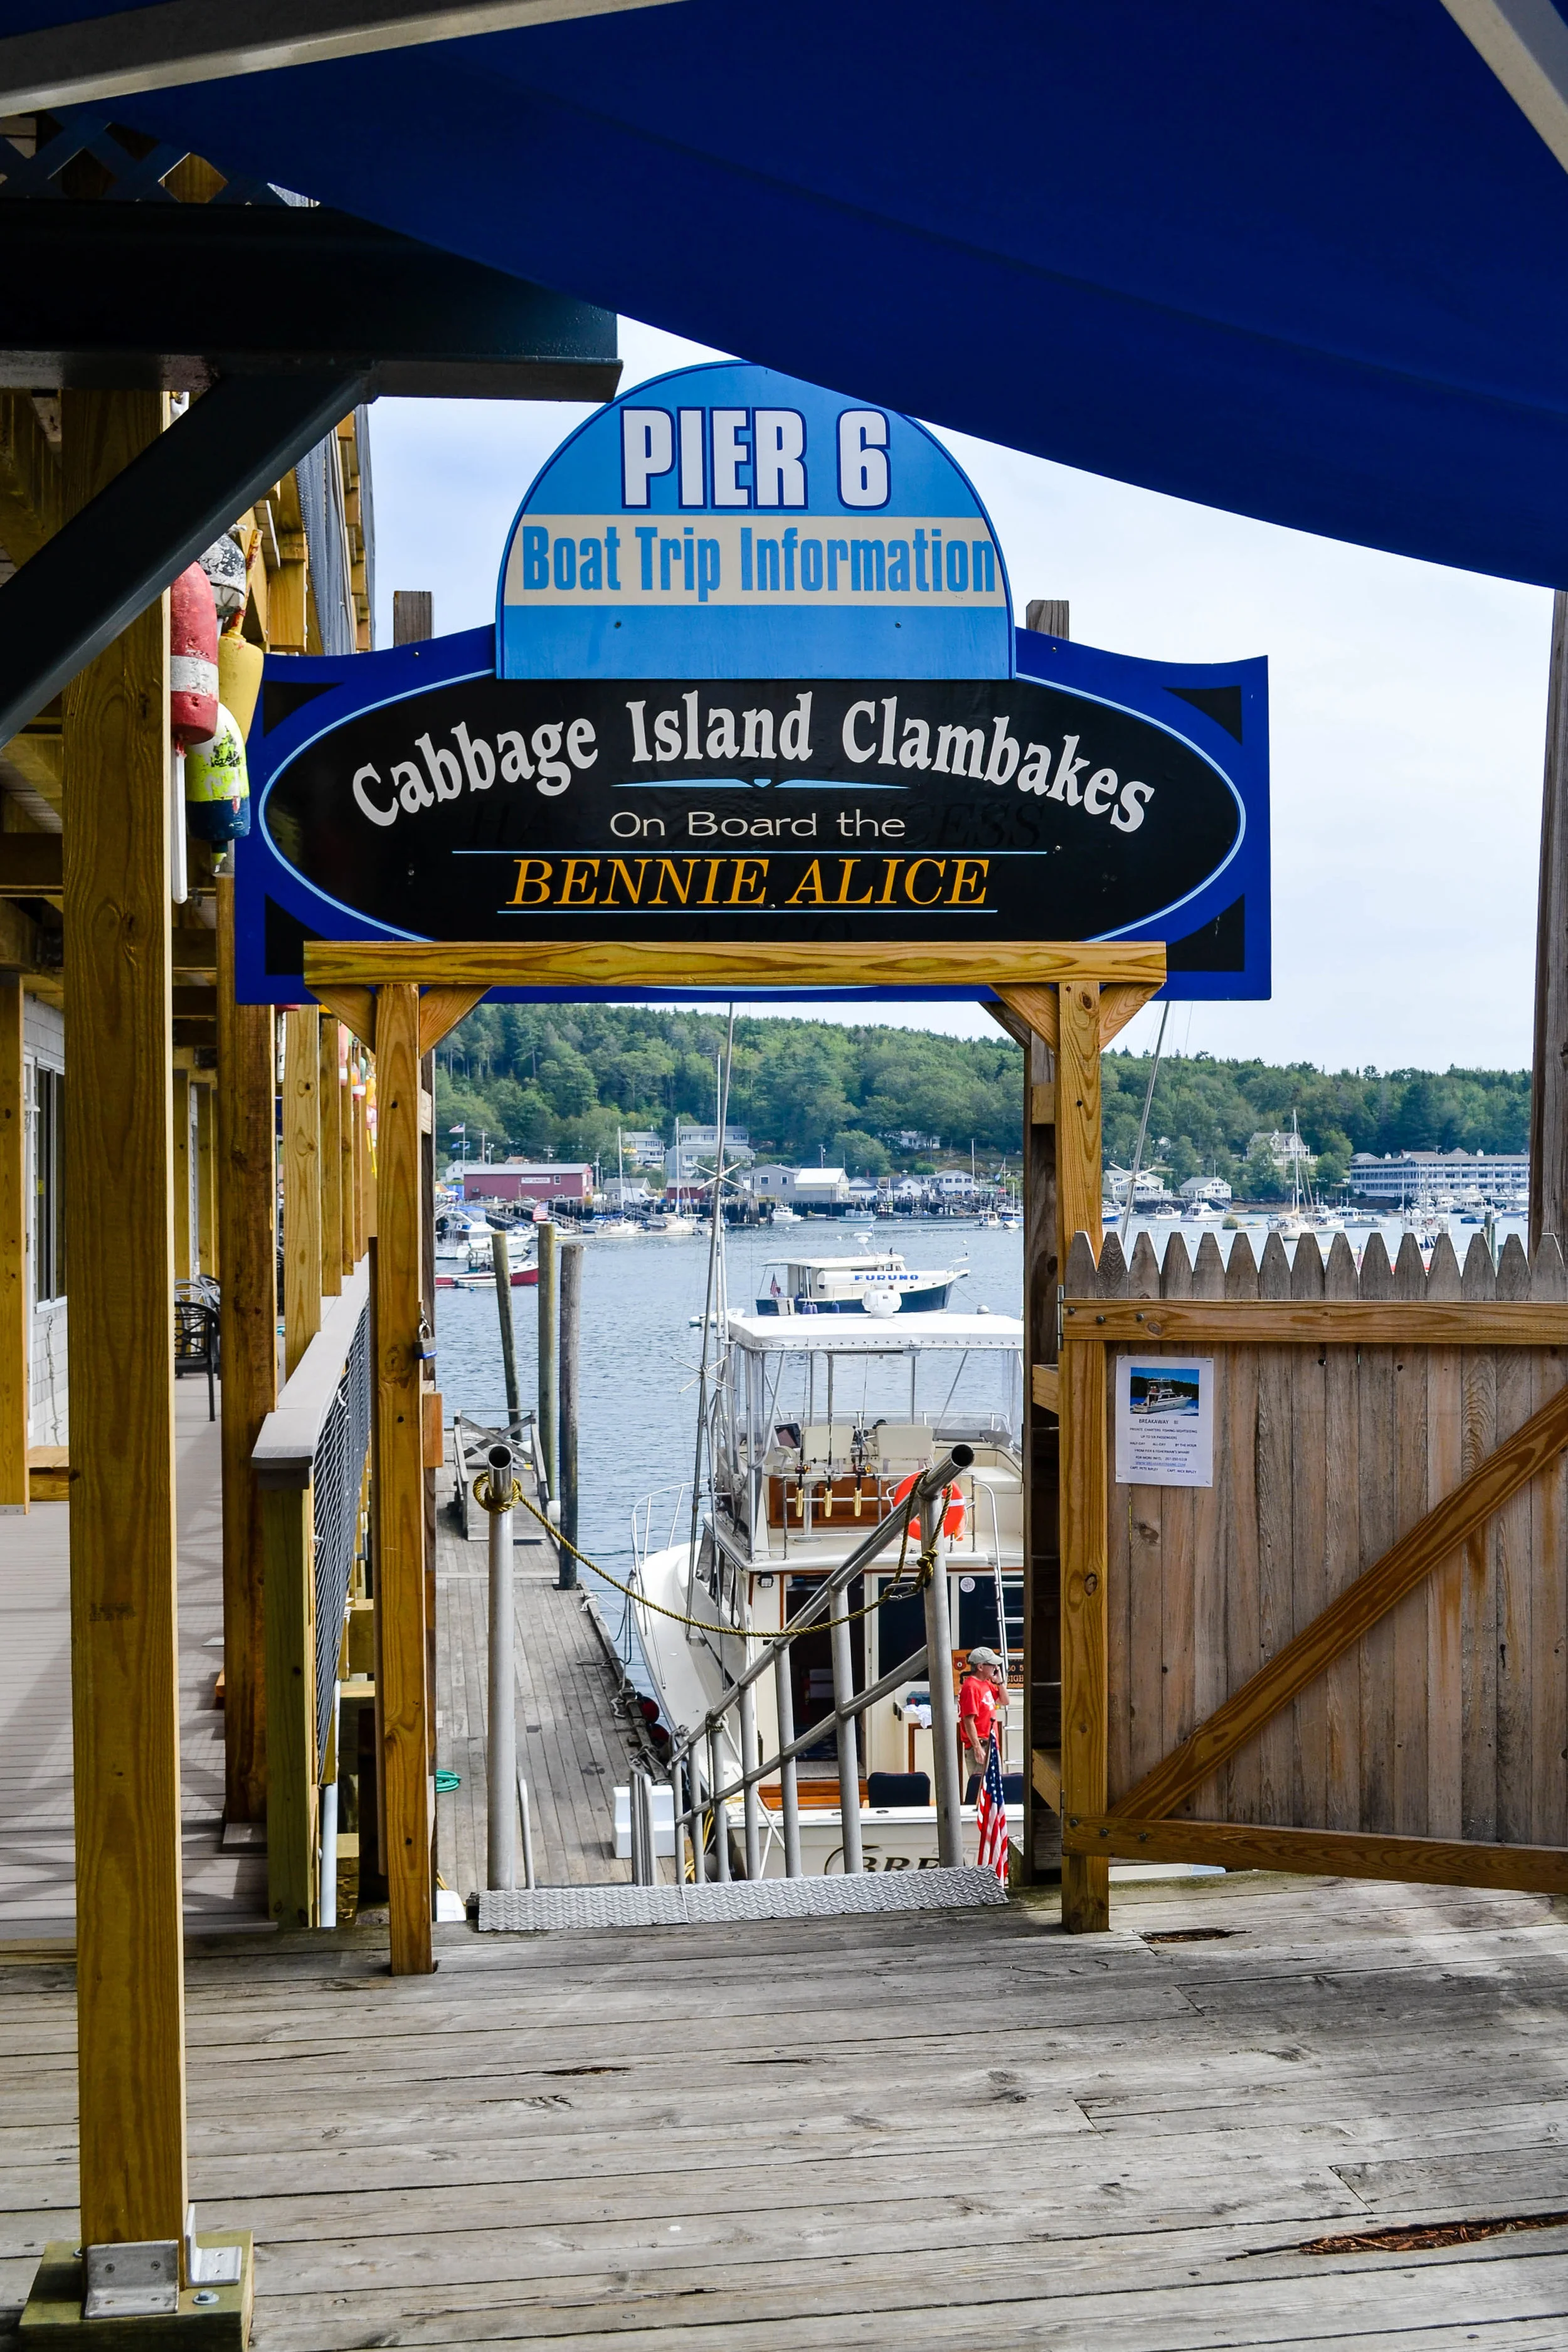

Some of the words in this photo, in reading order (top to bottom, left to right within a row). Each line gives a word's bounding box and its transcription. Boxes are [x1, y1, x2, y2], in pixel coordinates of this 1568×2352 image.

[620, 406, 808, 510] PIER
[837, 407, 891, 511] 6
[522, 526, 621, 591] Boat
[635, 527, 721, 602] Trip
[740, 527, 996, 592] Information
[352, 718, 598, 826] Cabbage
[625, 690, 814, 763] Island
[842, 696, 1155, 832] Clambakes
[610, 811, 665, 838] On
[688, 812, 817, 838] Board
[836, 808, 906, 838] the
[506, 859, 770, 905] BENNIE
[785, 858, 990, 905] ALICE
